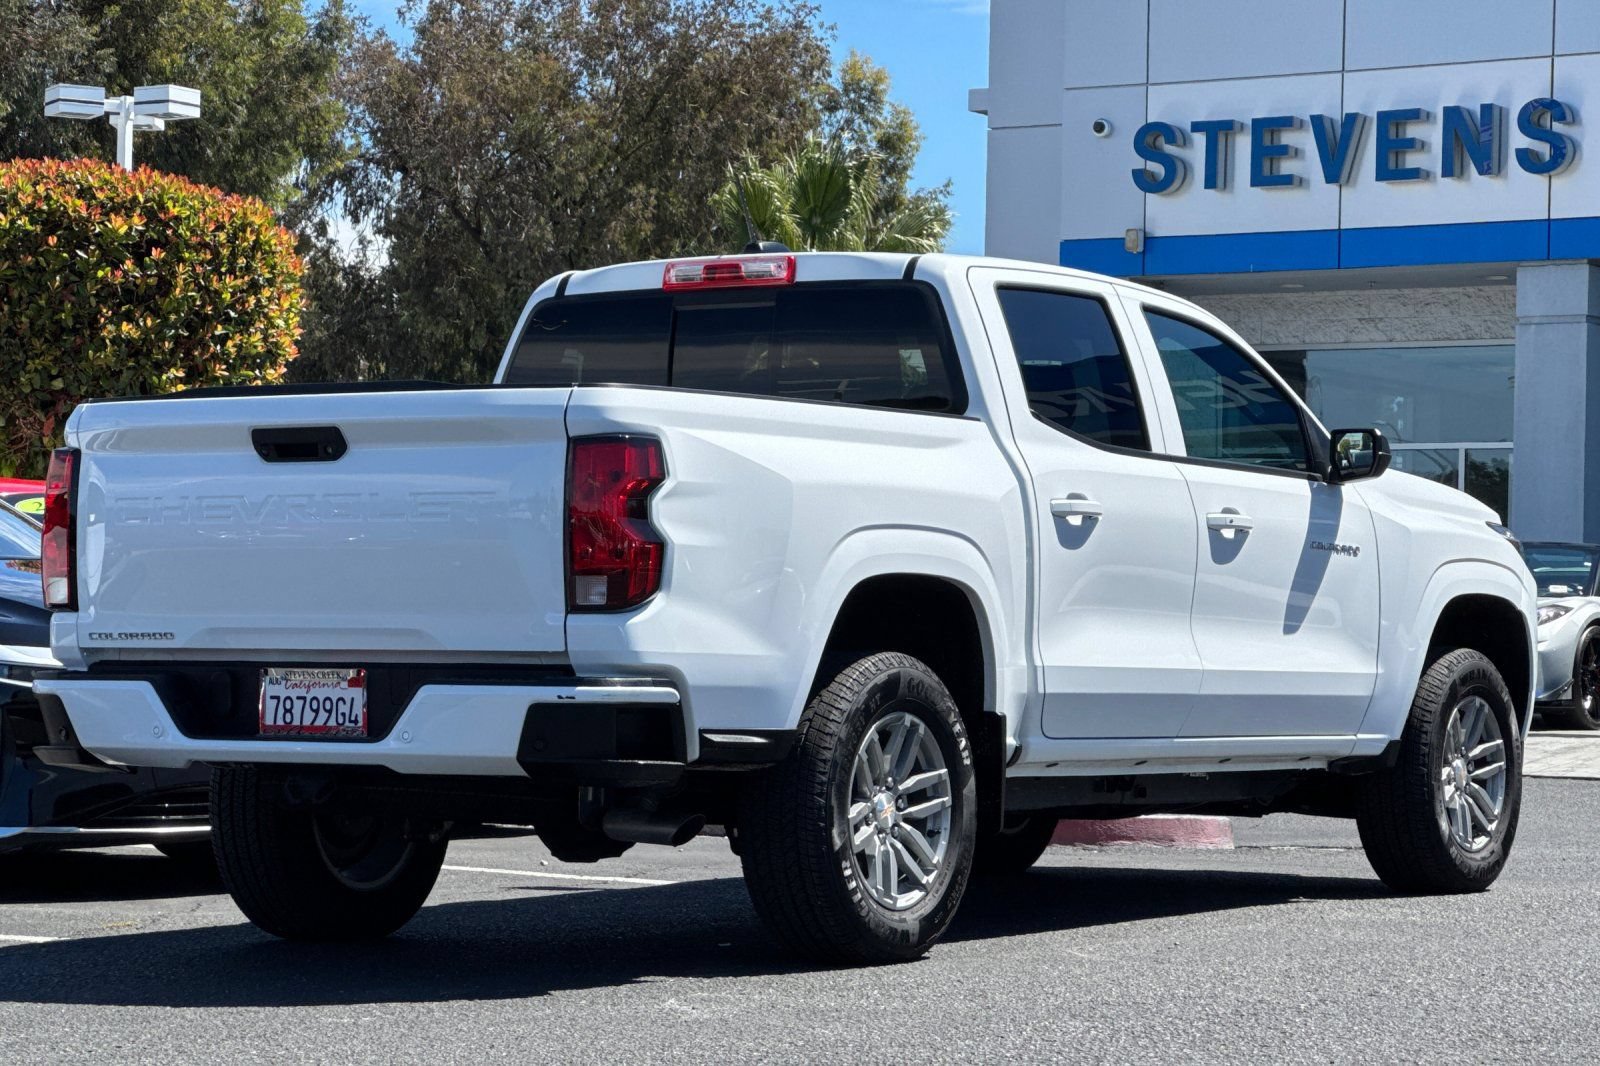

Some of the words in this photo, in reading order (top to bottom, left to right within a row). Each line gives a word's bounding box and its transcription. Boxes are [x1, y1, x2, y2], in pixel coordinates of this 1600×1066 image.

[1131, 97, 1577, 195] STEVENS
[1311, 541, 1361, 556] COLORADO
[88, 631, 175, 641] COLORADO
[284, 670, 315, 680] STEVENS
[316, 671, 342, 680] CREEK
[285, 679, 348, 694] California
[269, 695, 359, 726] 78799G4
